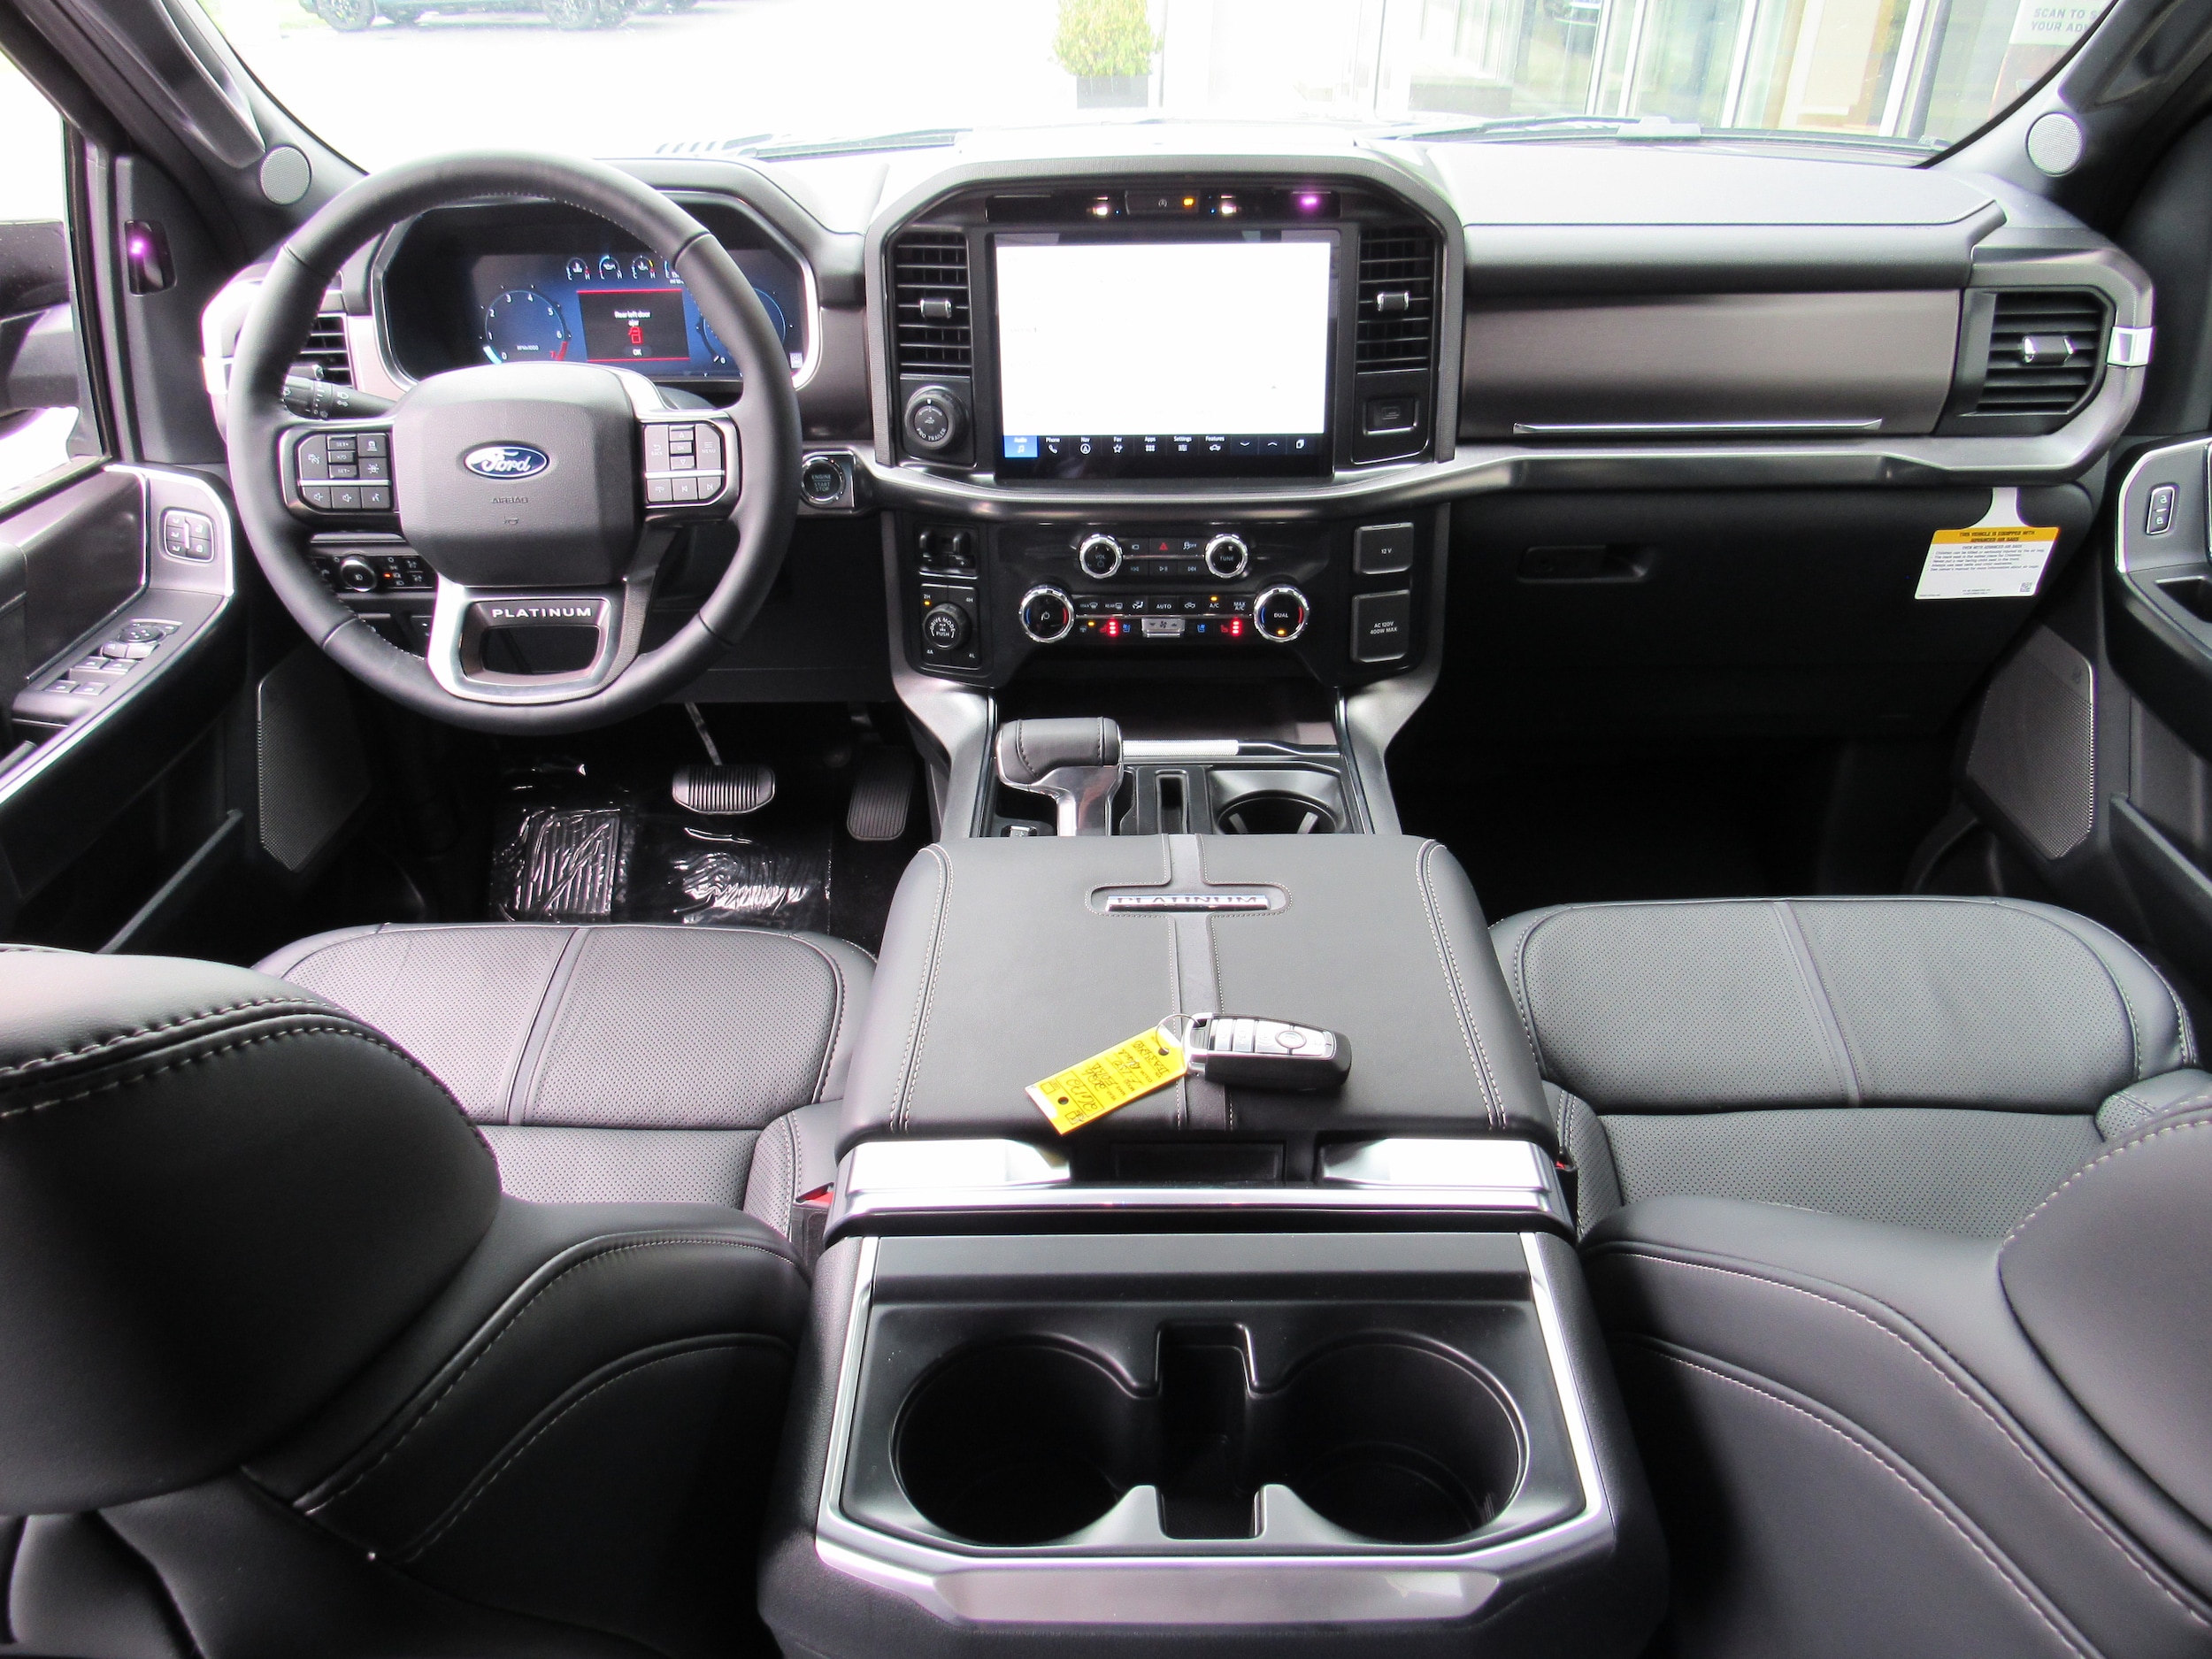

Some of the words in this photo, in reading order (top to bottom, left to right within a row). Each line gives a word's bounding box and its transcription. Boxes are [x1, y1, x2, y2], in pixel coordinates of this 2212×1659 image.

[2033, 8, 2066, 18] SCAN
[2070, 9, 2085, 19] TO
[2032, 21, 2062, 32] YOUR
[505, 294, 512, 303] 3
[489, 309, 495, 318] 2
[548, 307, 554, 316] 5
[627, 310, 637, 319] left
[637, 310, 651, 319] door
[557, 330, 563, 339] 6
[632, 348, 643, 357] OK
[916, 427, 927, 439] PRO
[927, 427, 947, 442] TRAILER
[480, 450, 532, 472] Ford
[491, 608, 592, 618] PLATINUM
[930, 617, 942, 631] DRIVE
[942, 617, 956, 632] MODE
